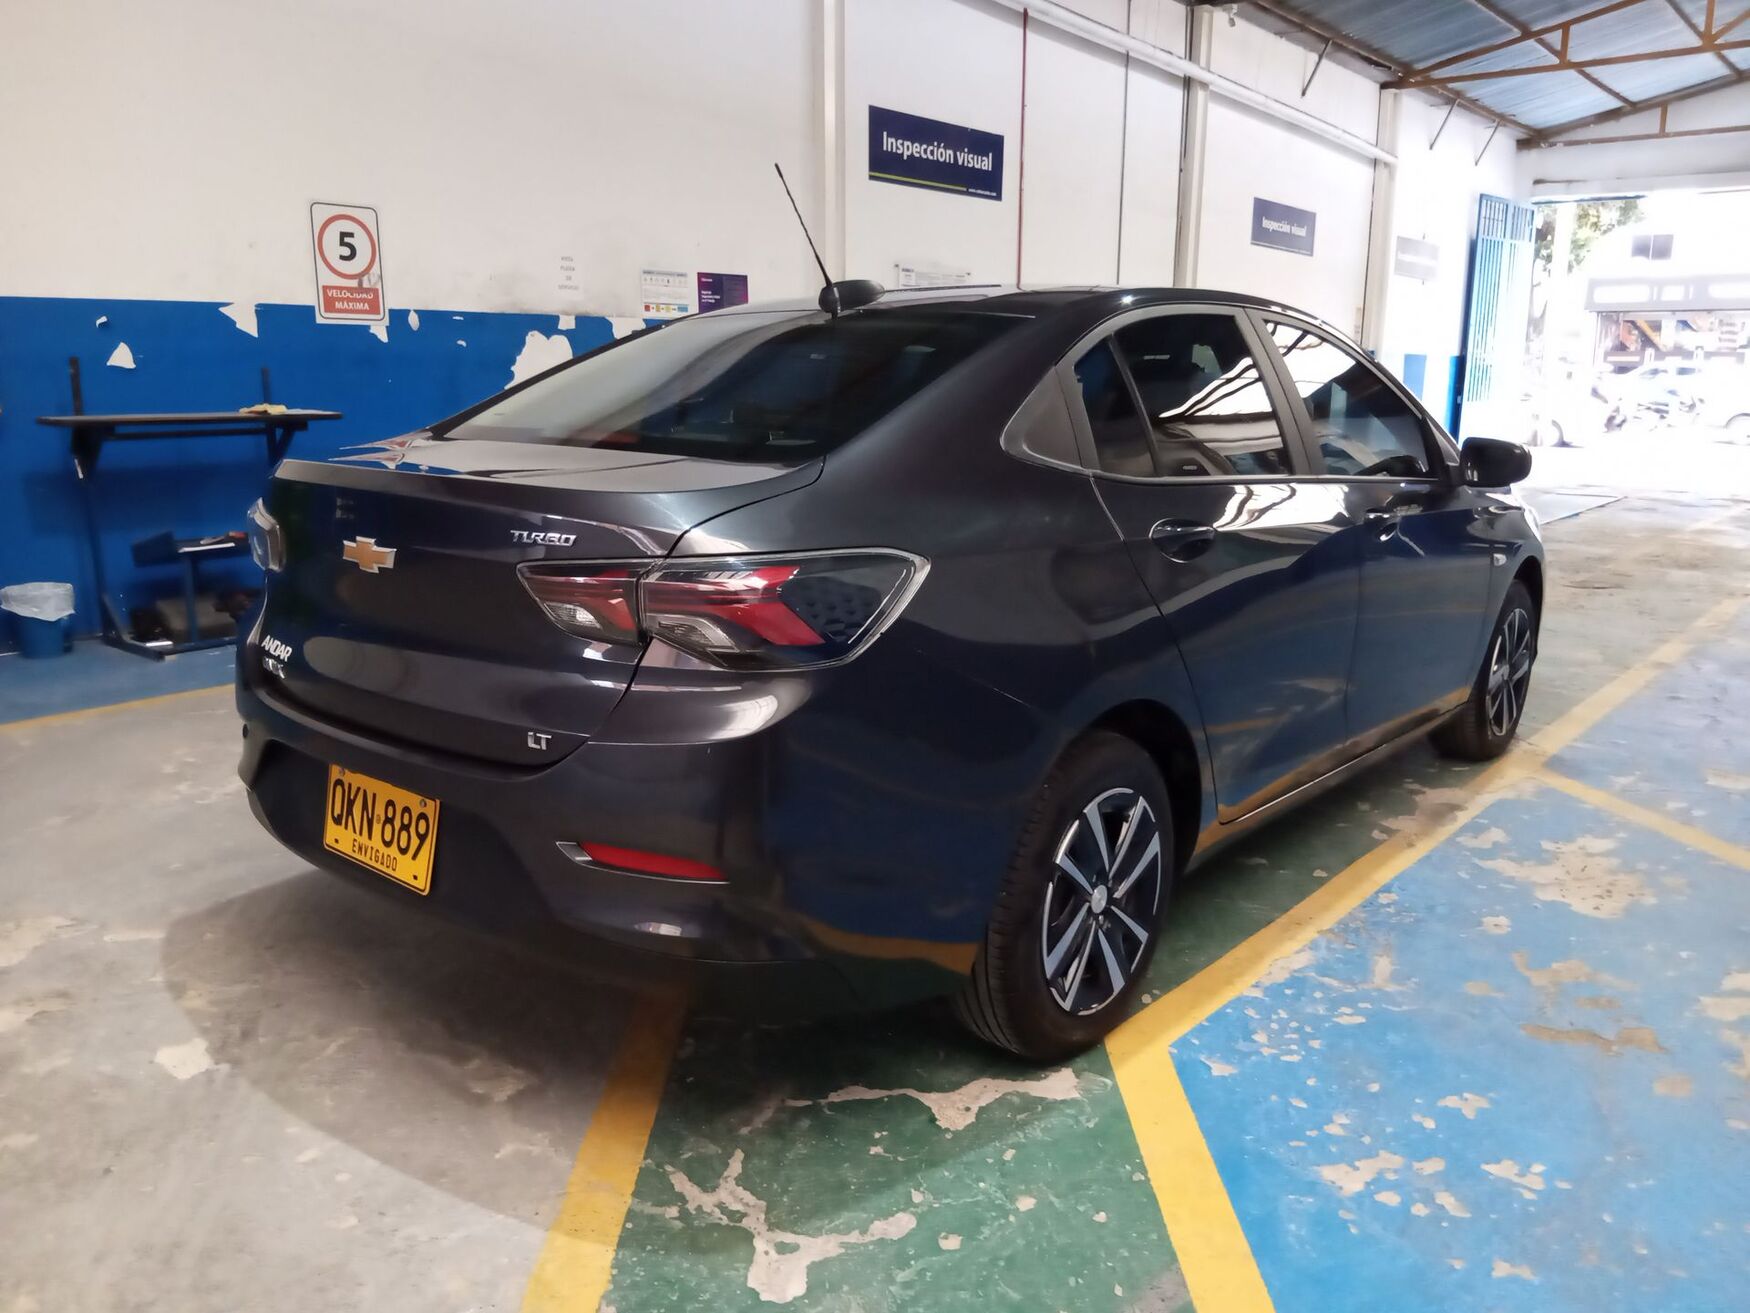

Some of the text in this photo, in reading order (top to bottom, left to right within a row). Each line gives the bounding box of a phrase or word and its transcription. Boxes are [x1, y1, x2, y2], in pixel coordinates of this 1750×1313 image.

[882, 131, 993, 171] Inspección visual
[339, 231, 358, 261] 5
[335, 301, 370, 311] MÁXIMA
[510, 530, 577, 546] TURBO
[261, 634, 293, 662] ANDAR
[528, 732, 552, 750] LT
[352, 838, 398, 872] ENVIGADO
